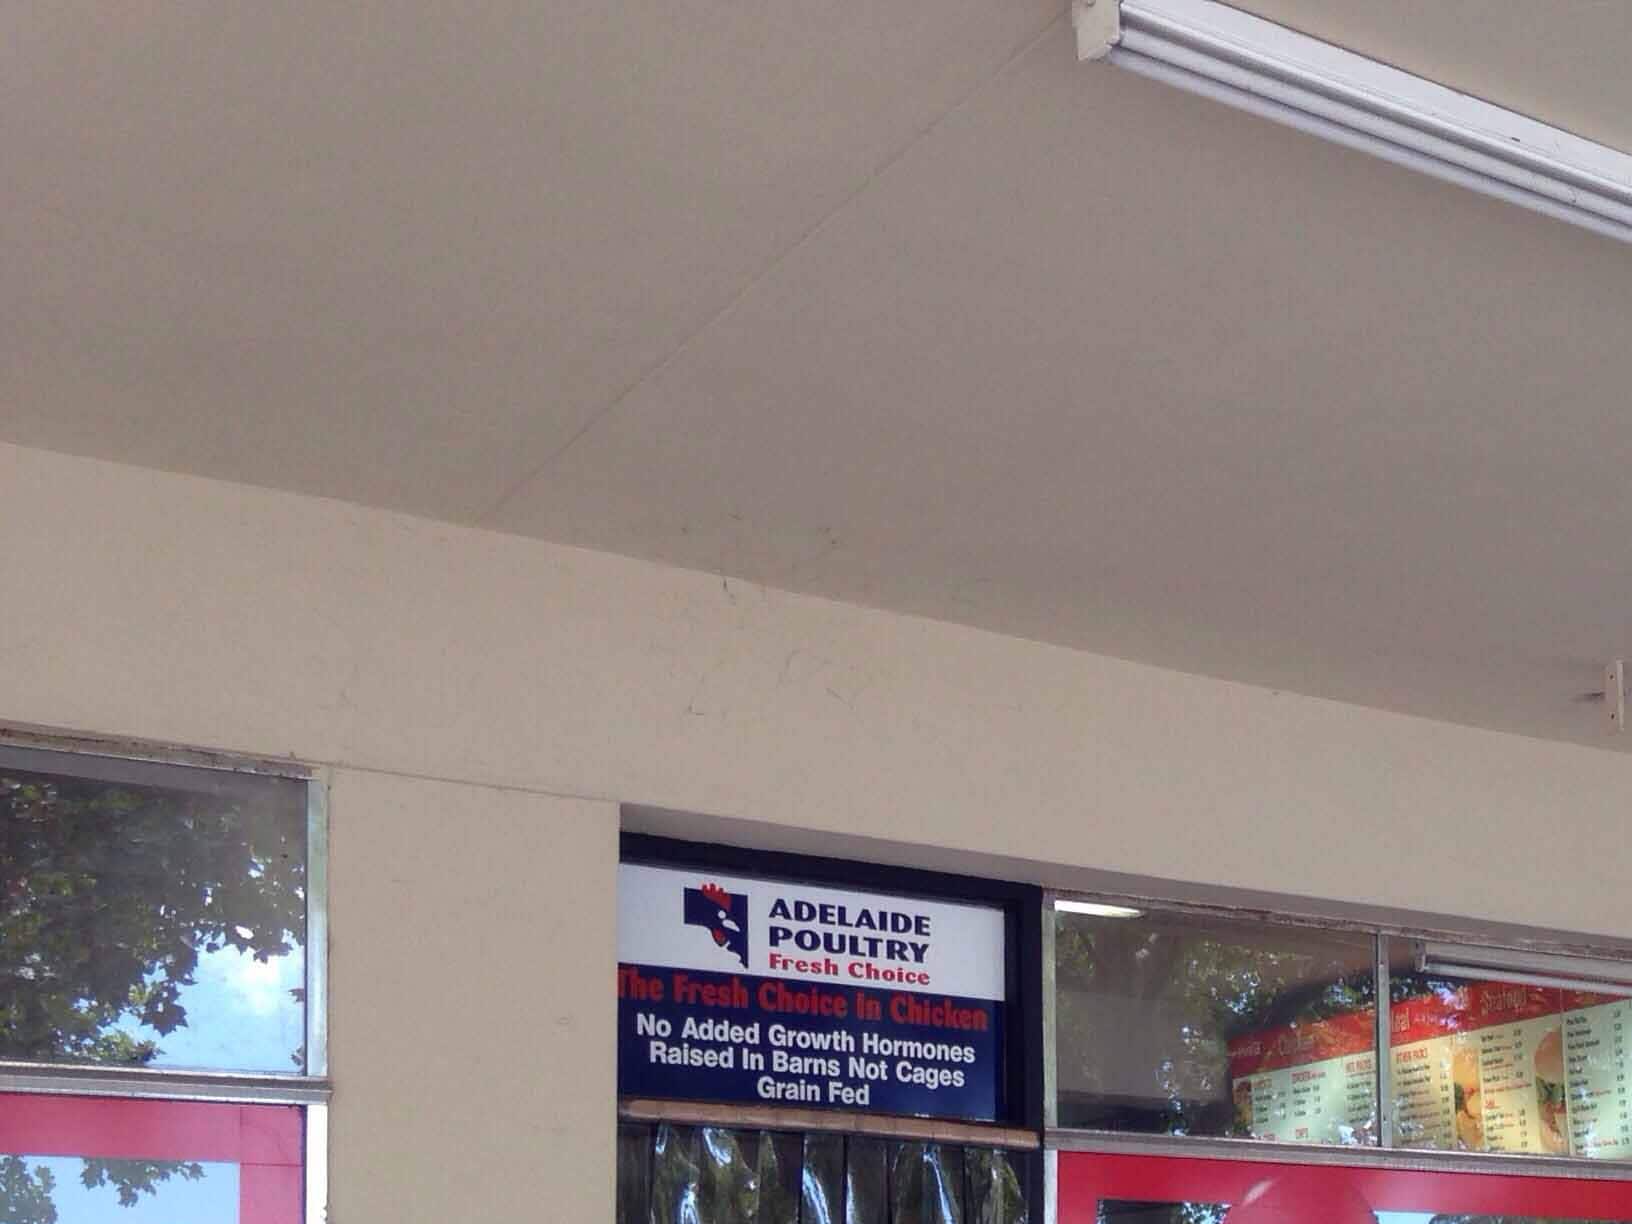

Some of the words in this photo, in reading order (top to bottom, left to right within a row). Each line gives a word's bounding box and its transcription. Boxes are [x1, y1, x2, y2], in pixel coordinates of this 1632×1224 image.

[769, 898, 931, 937] ADELAIDE
[769, 929, 930, 964] POULTRY
[769, 952, 838, 977] Fresh
[848, 961, 931, 986] Choice
[673, 974, 748, 1010] Fresh
[760, 981, 848, 1018] Choice
[889, 994, 989, 1031] Chicken
[636, 1012, 672, 1037] No
[681, 1016, 760, 1045] Added
[768, 1023, 855, 1054] Growth
[862, 1031, 976, 1064] Hormones
[649, 1040, 734, 1069] Raised
[742, 1047, 765, 1071] In
[772, 1050, 841, 1077] Barns
[848, 1057, 888, 1082] Not
[896, 1061, 966, 1089] Cages
[757, 1076, 821, 1102] Grain
[828, 1081, 870, 1105] Fed
